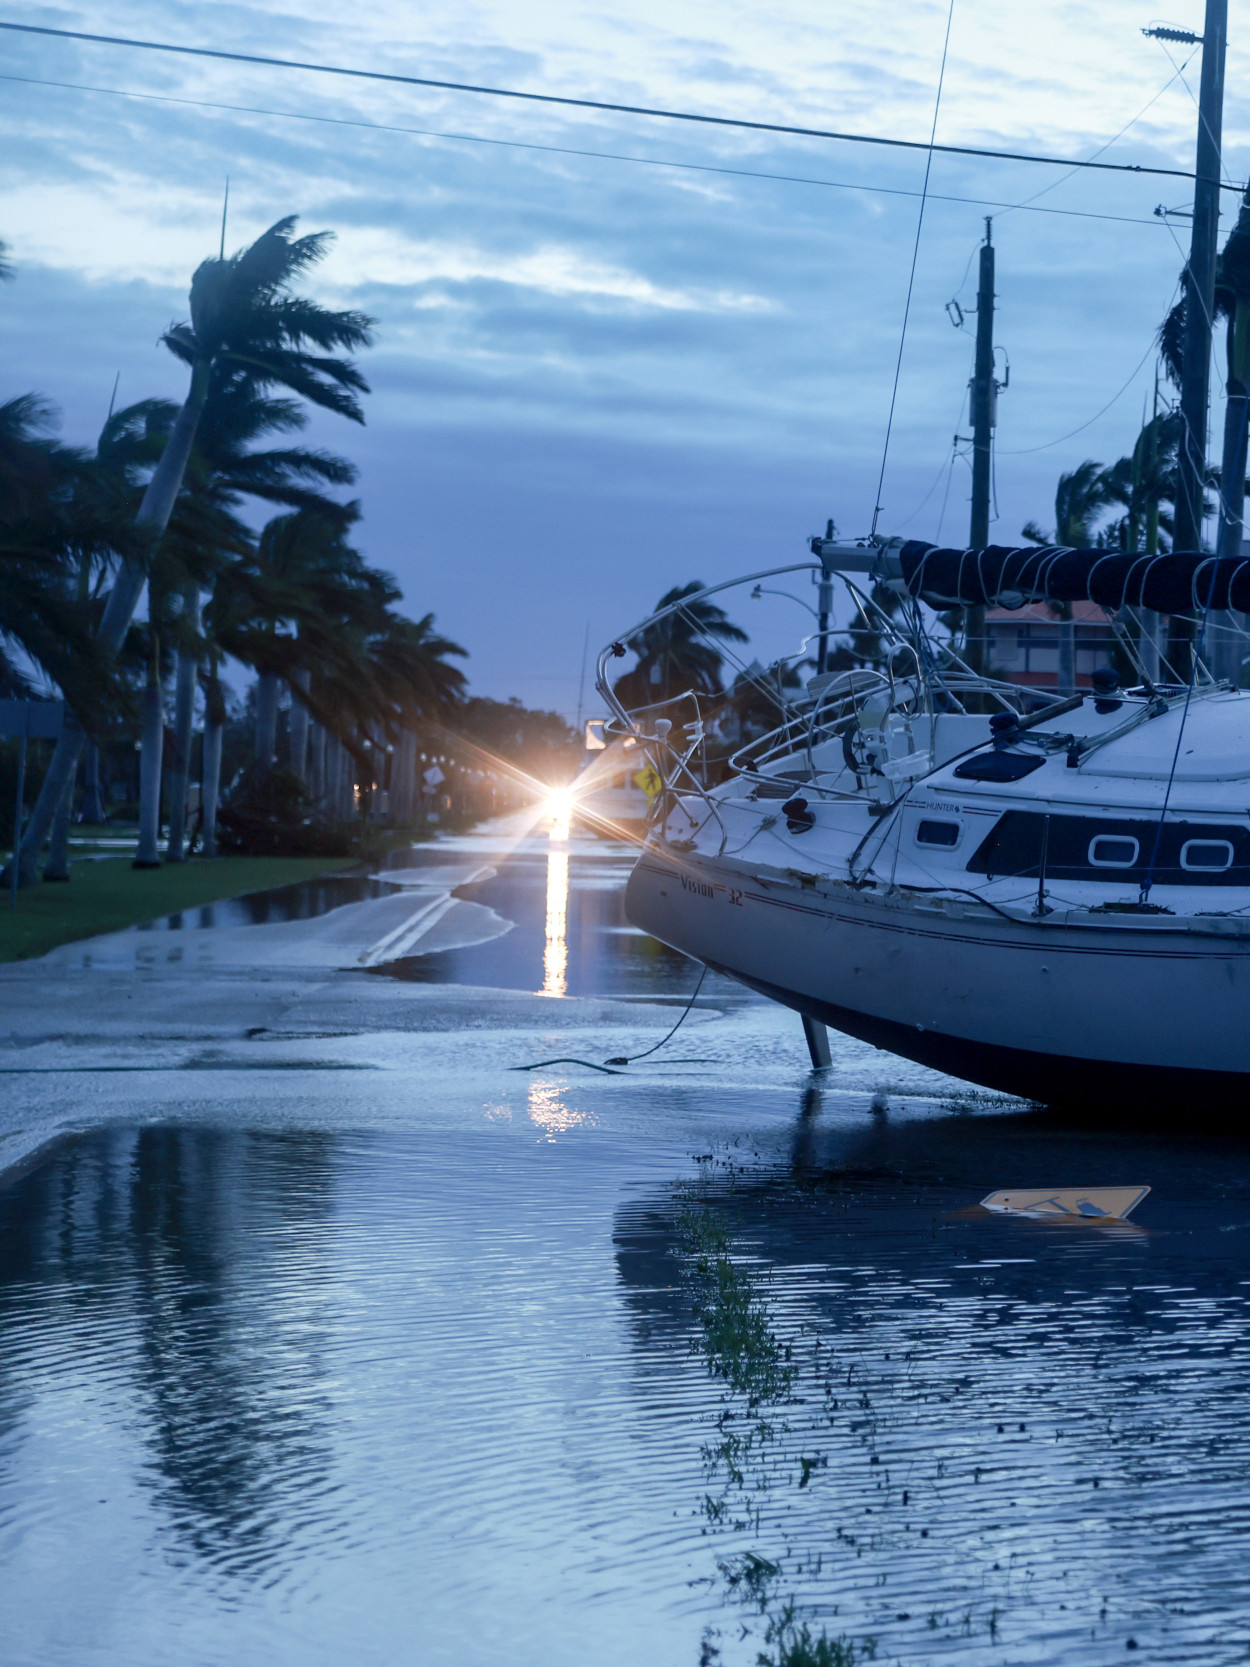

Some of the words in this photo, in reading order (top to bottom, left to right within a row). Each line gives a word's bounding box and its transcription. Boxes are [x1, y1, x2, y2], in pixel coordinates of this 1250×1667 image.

[926, 802, 955, 812] HUNTER
[680, 873, 715, 899] Vision
[728, 886, 744, 906] 32
